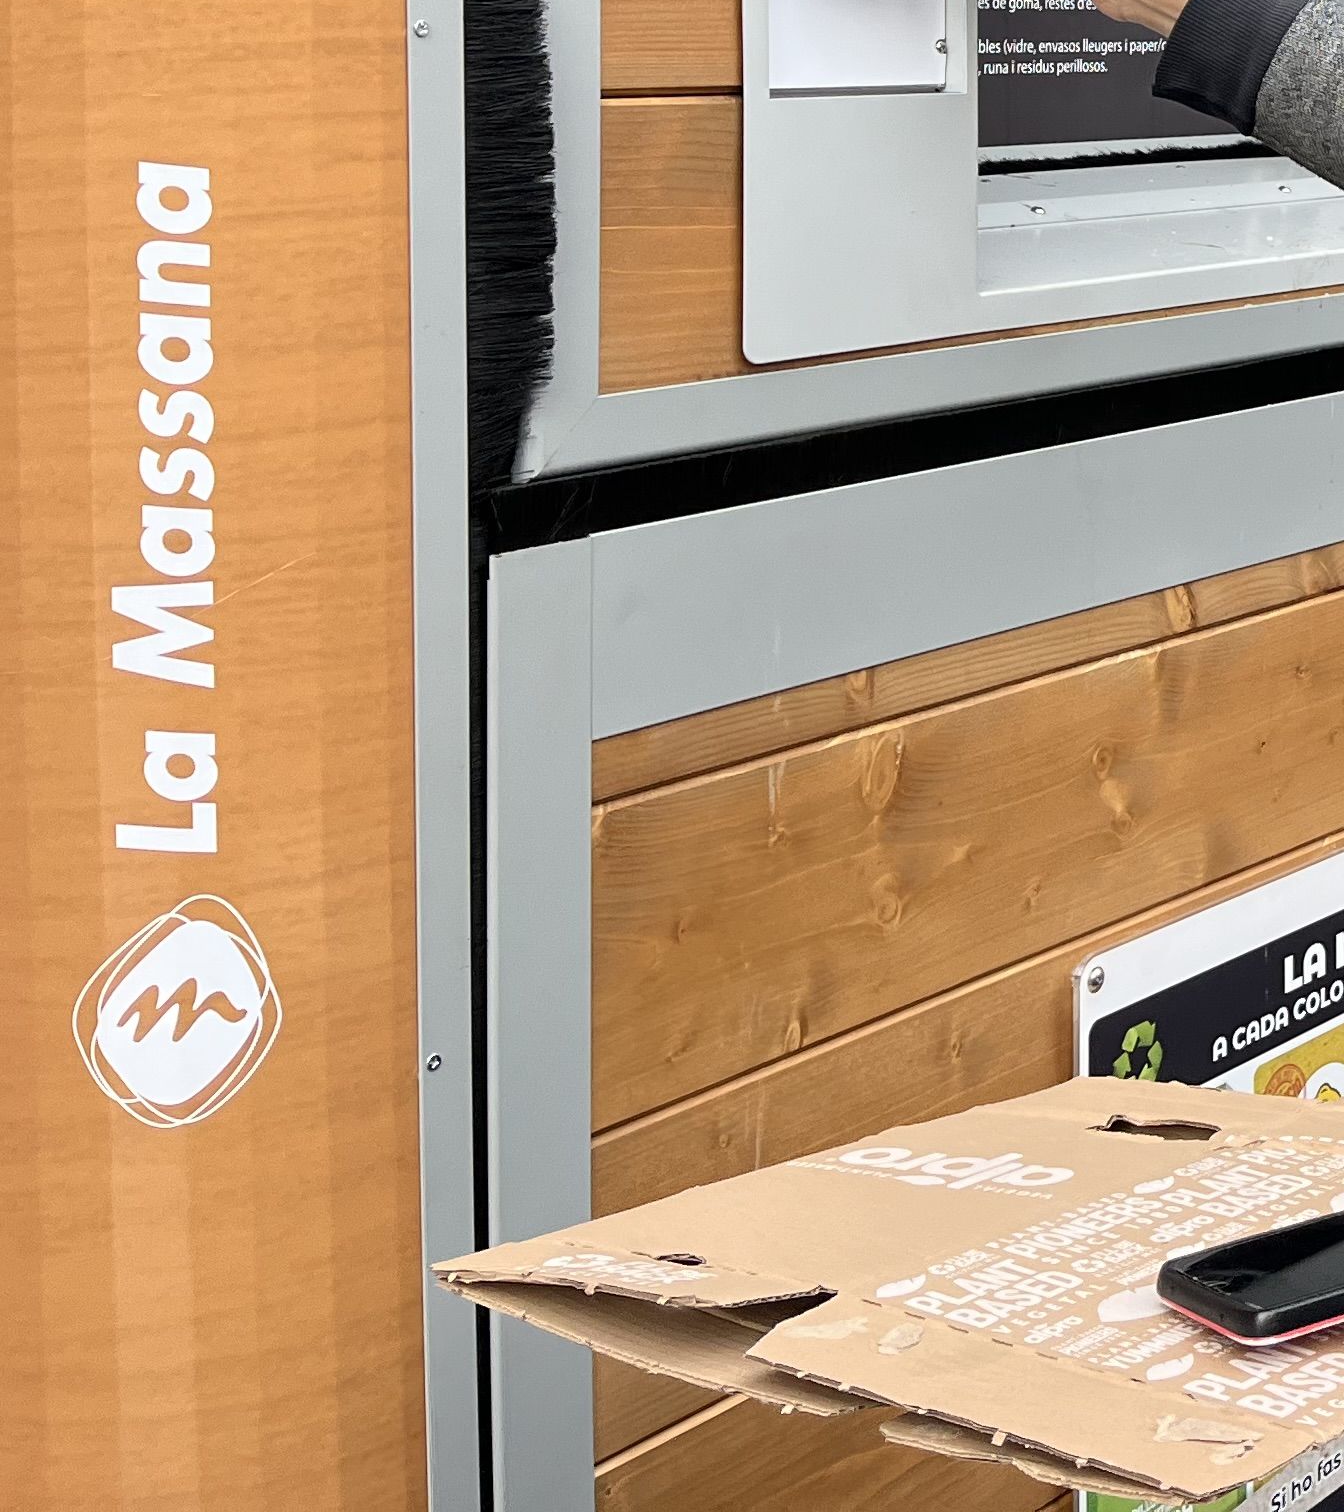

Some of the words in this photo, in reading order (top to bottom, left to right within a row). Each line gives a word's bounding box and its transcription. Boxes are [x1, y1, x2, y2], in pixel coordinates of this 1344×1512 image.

[984, 62, 1008, 74] runa
[1016, 59, 1054, 74] residus
[1056, 59, 1108, 76] perillosos.
[1003, 39, 1036, 56] (vidre,
[1038, 42, 1080, 54] envasos
[1082, 38, 1122, 56] lleugers
[110, 161, 215, 689] Massana
[115, 730, 218, 853] La
[1284, 942, 1326, 994] LA
[1212, 1036, 1228, 1062] A
[1232, 1006, 1289, 1050] CADA
[839, 1146, 1074, 1190] alpro
[1161, 1165, 1272, 1209] PLANT
[1196, 1175, 1314, 1218] BASED
[1243, 1184, 1335, 1223] VEGETAL
[1002, 1196, 1164, 1260] PIONEERS
[1040, 1230, 1121, 1265] SINCE
[904, 1258, 1038, 1316] PLANT
[944, 1270, 1084, 1328] BASED
[992, 1284, 1108, 1334] VEGETAL
[1023, 1315, 1084, 1346] alpro
[1183, 1343, 1316, 1403] PLANT
[1271, 1486, 1287, 1512] Si
[1291, 1474, 1312, 1502] ho
[1317, 1452, 1342, 1482] fas
